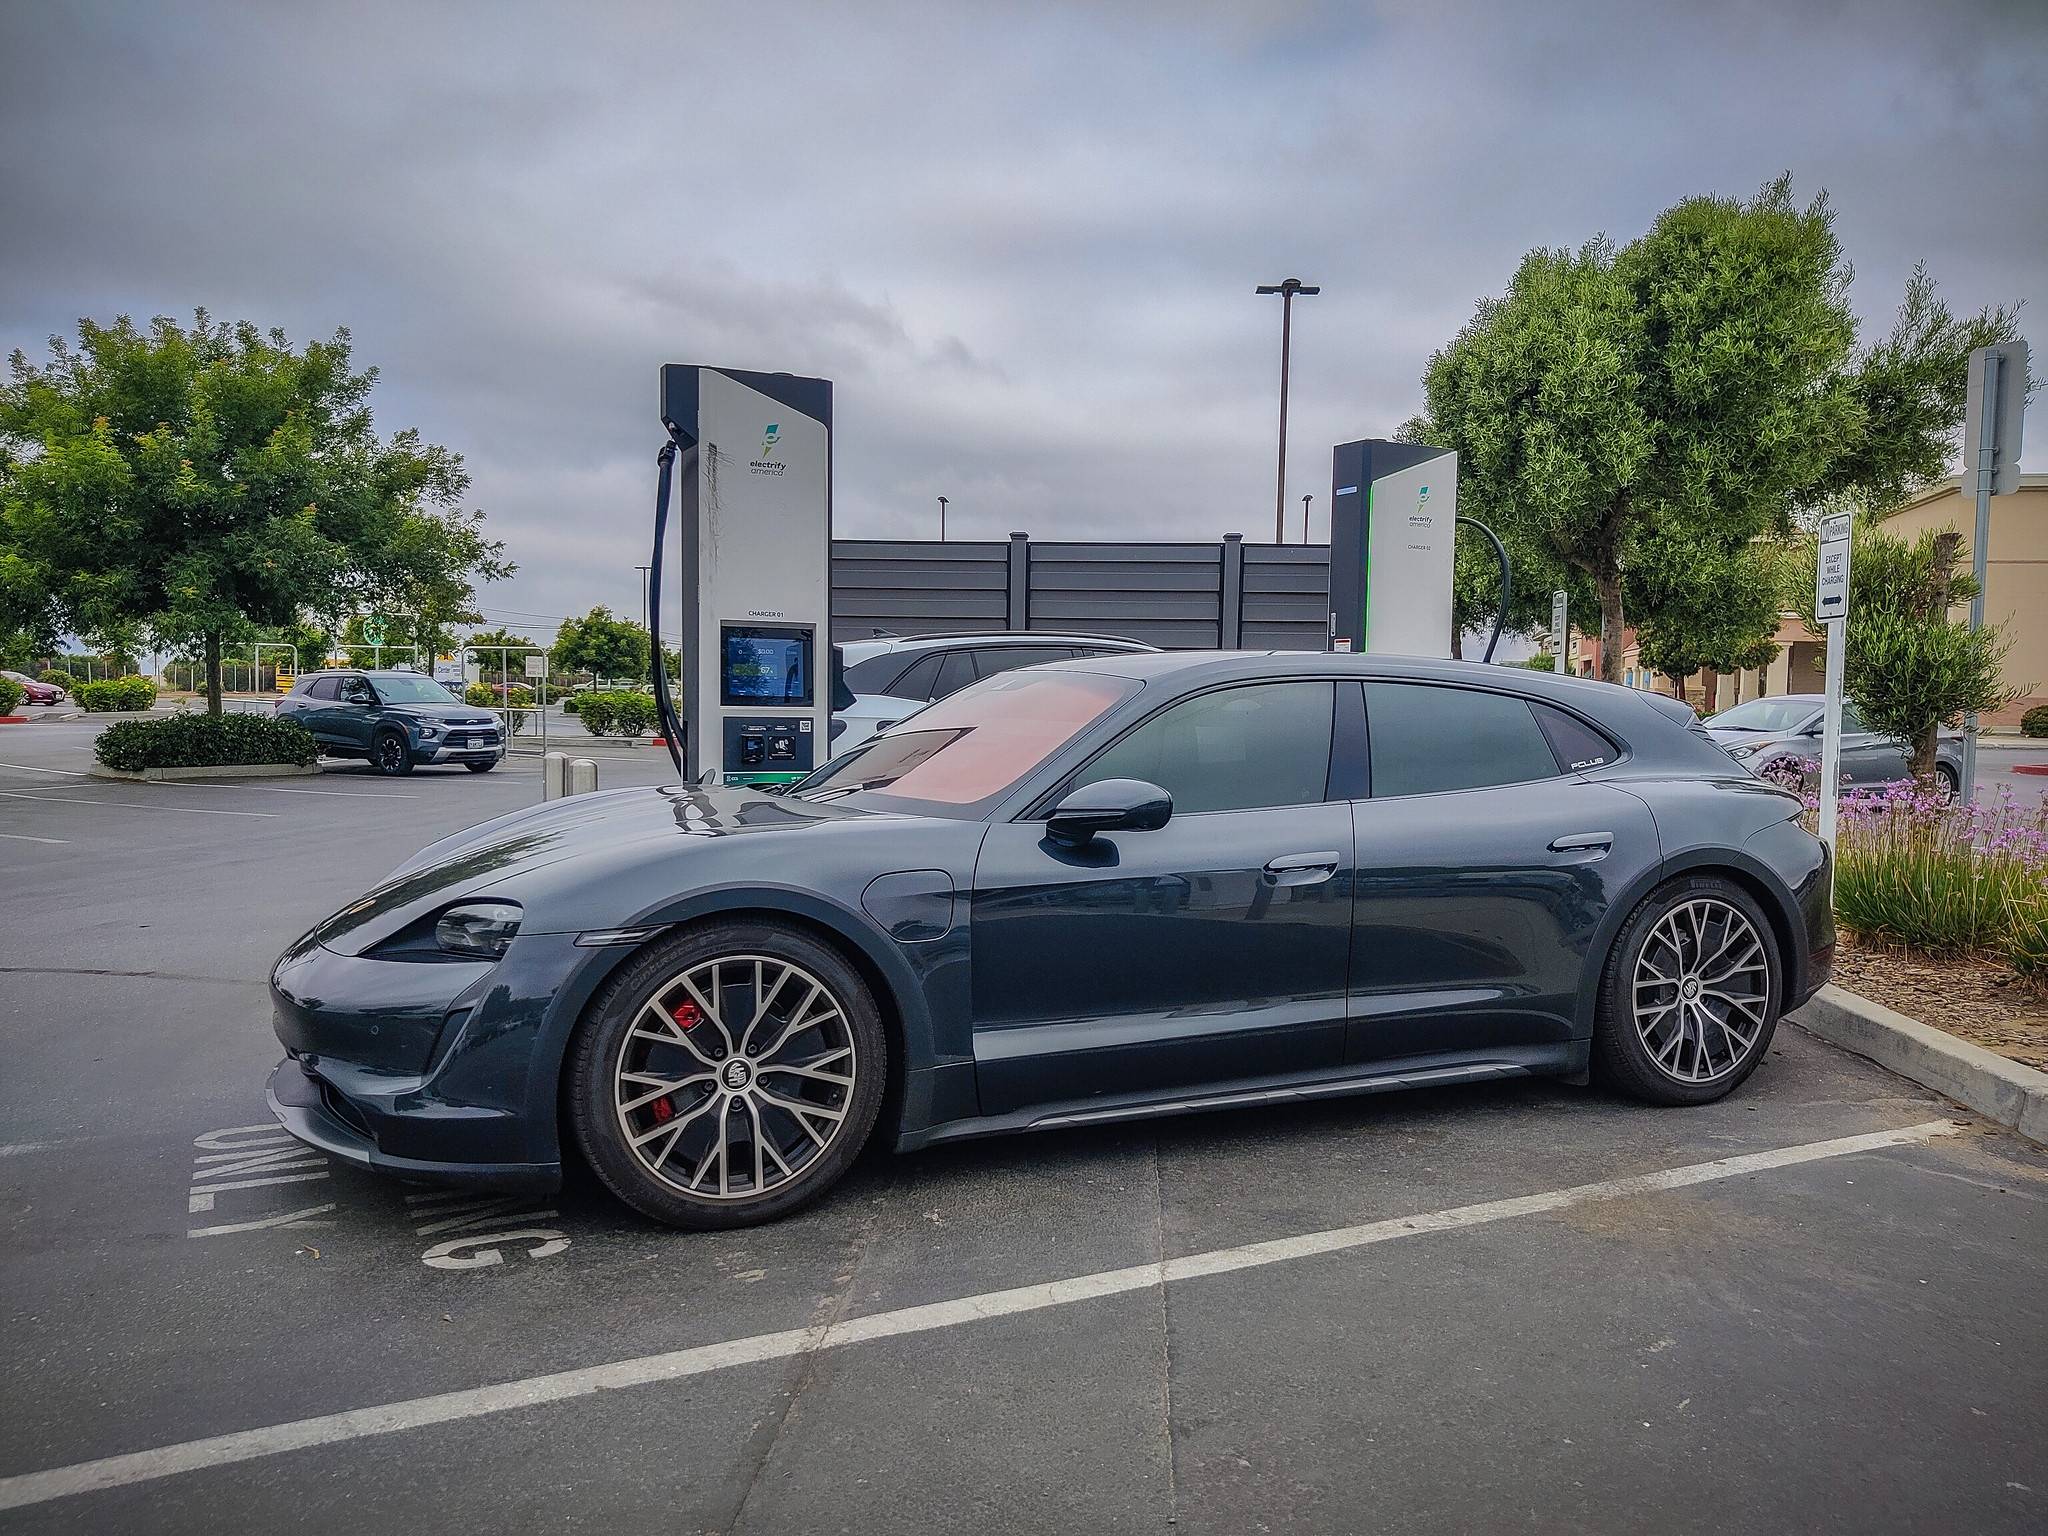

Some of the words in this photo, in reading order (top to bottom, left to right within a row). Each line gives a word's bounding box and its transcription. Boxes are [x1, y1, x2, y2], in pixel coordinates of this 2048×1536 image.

[750, 461, 786, 471] electrify
[1409, 516, 1432, 524] electrify
[1825, 553, 1842, 564] EXCEPT
[1826, 564, 1840, 574] WHILE
[1822, 574, 1845, 586] CHARGING
[1570, 757, 1604, 770] PCLUB
